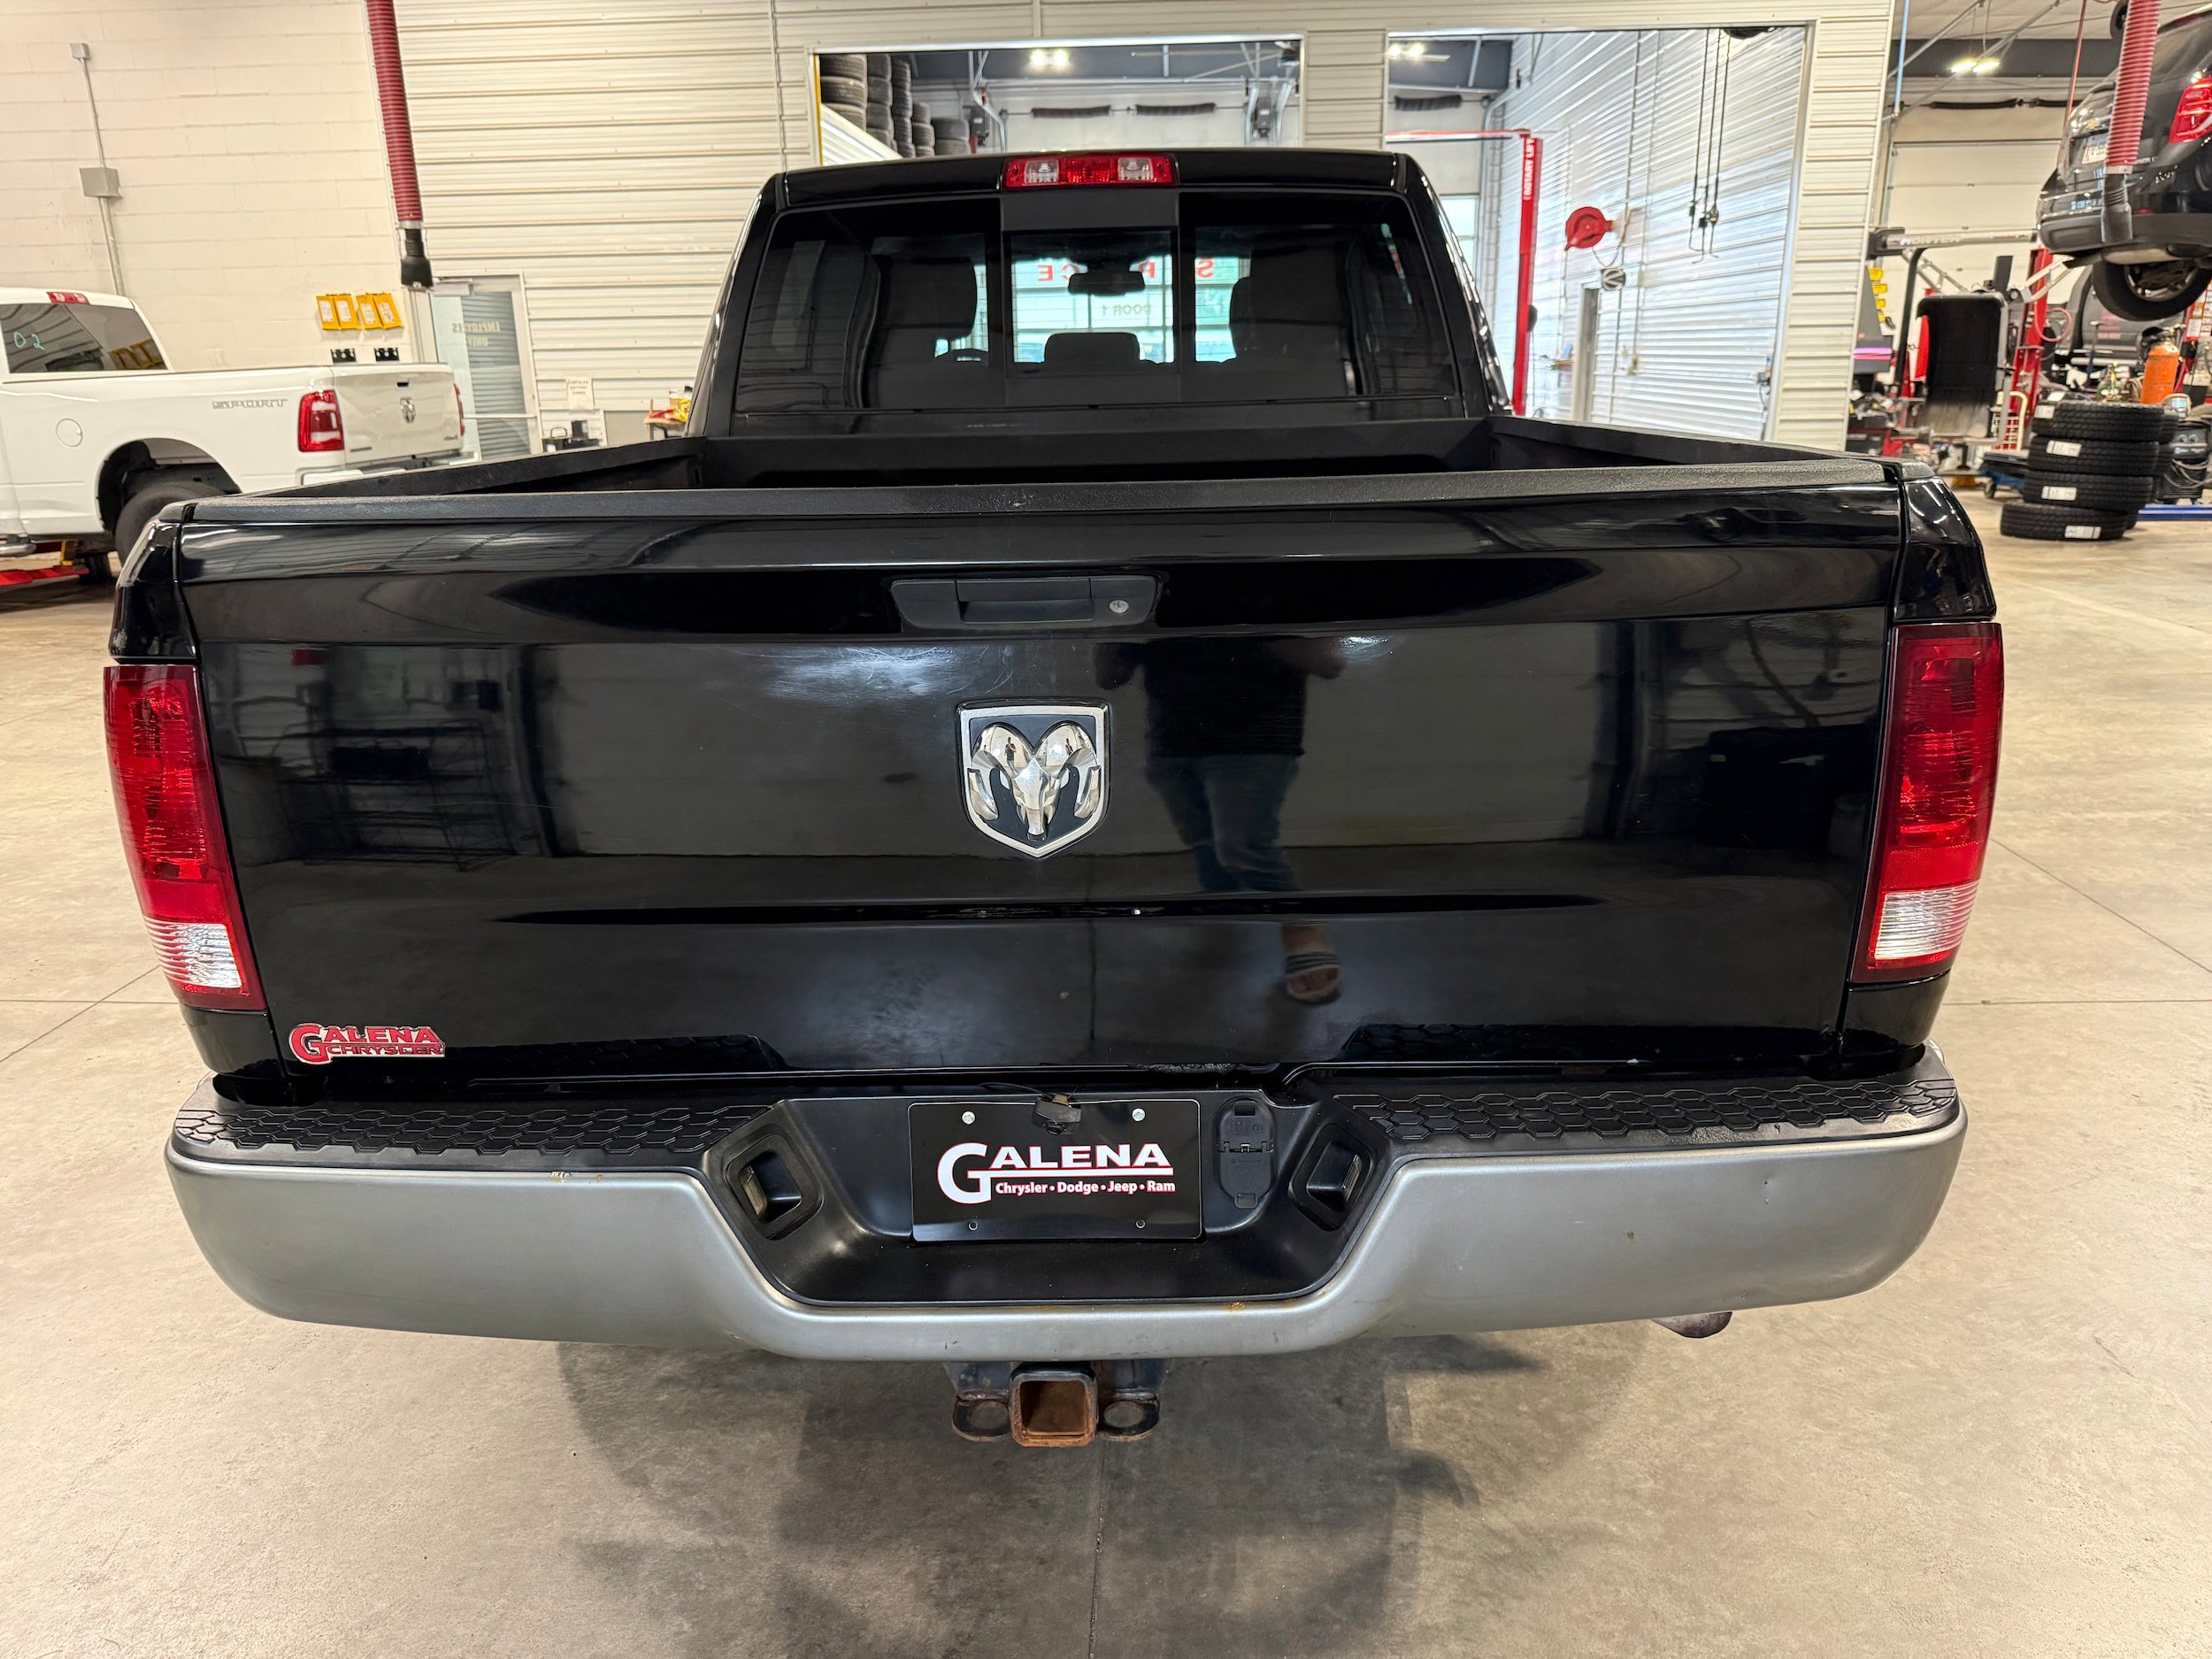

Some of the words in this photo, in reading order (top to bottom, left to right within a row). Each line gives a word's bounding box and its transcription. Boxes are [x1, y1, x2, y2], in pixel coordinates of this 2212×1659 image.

[211, 399, 288, 410] SPORT
[290, 1025, 441, 1063] GALENA
[327, 1045, 441, 1056] CHRYSLER
[936, 1141, 1173, 1204] GALENA
[995, 1181, 1048, 1196] Chrysler
[1057, 1181, 1099, 1194] Dodge
[1107, 1180, 1138, 1194] Jeep
[1147, 1180, 1176, 1193] Ram
